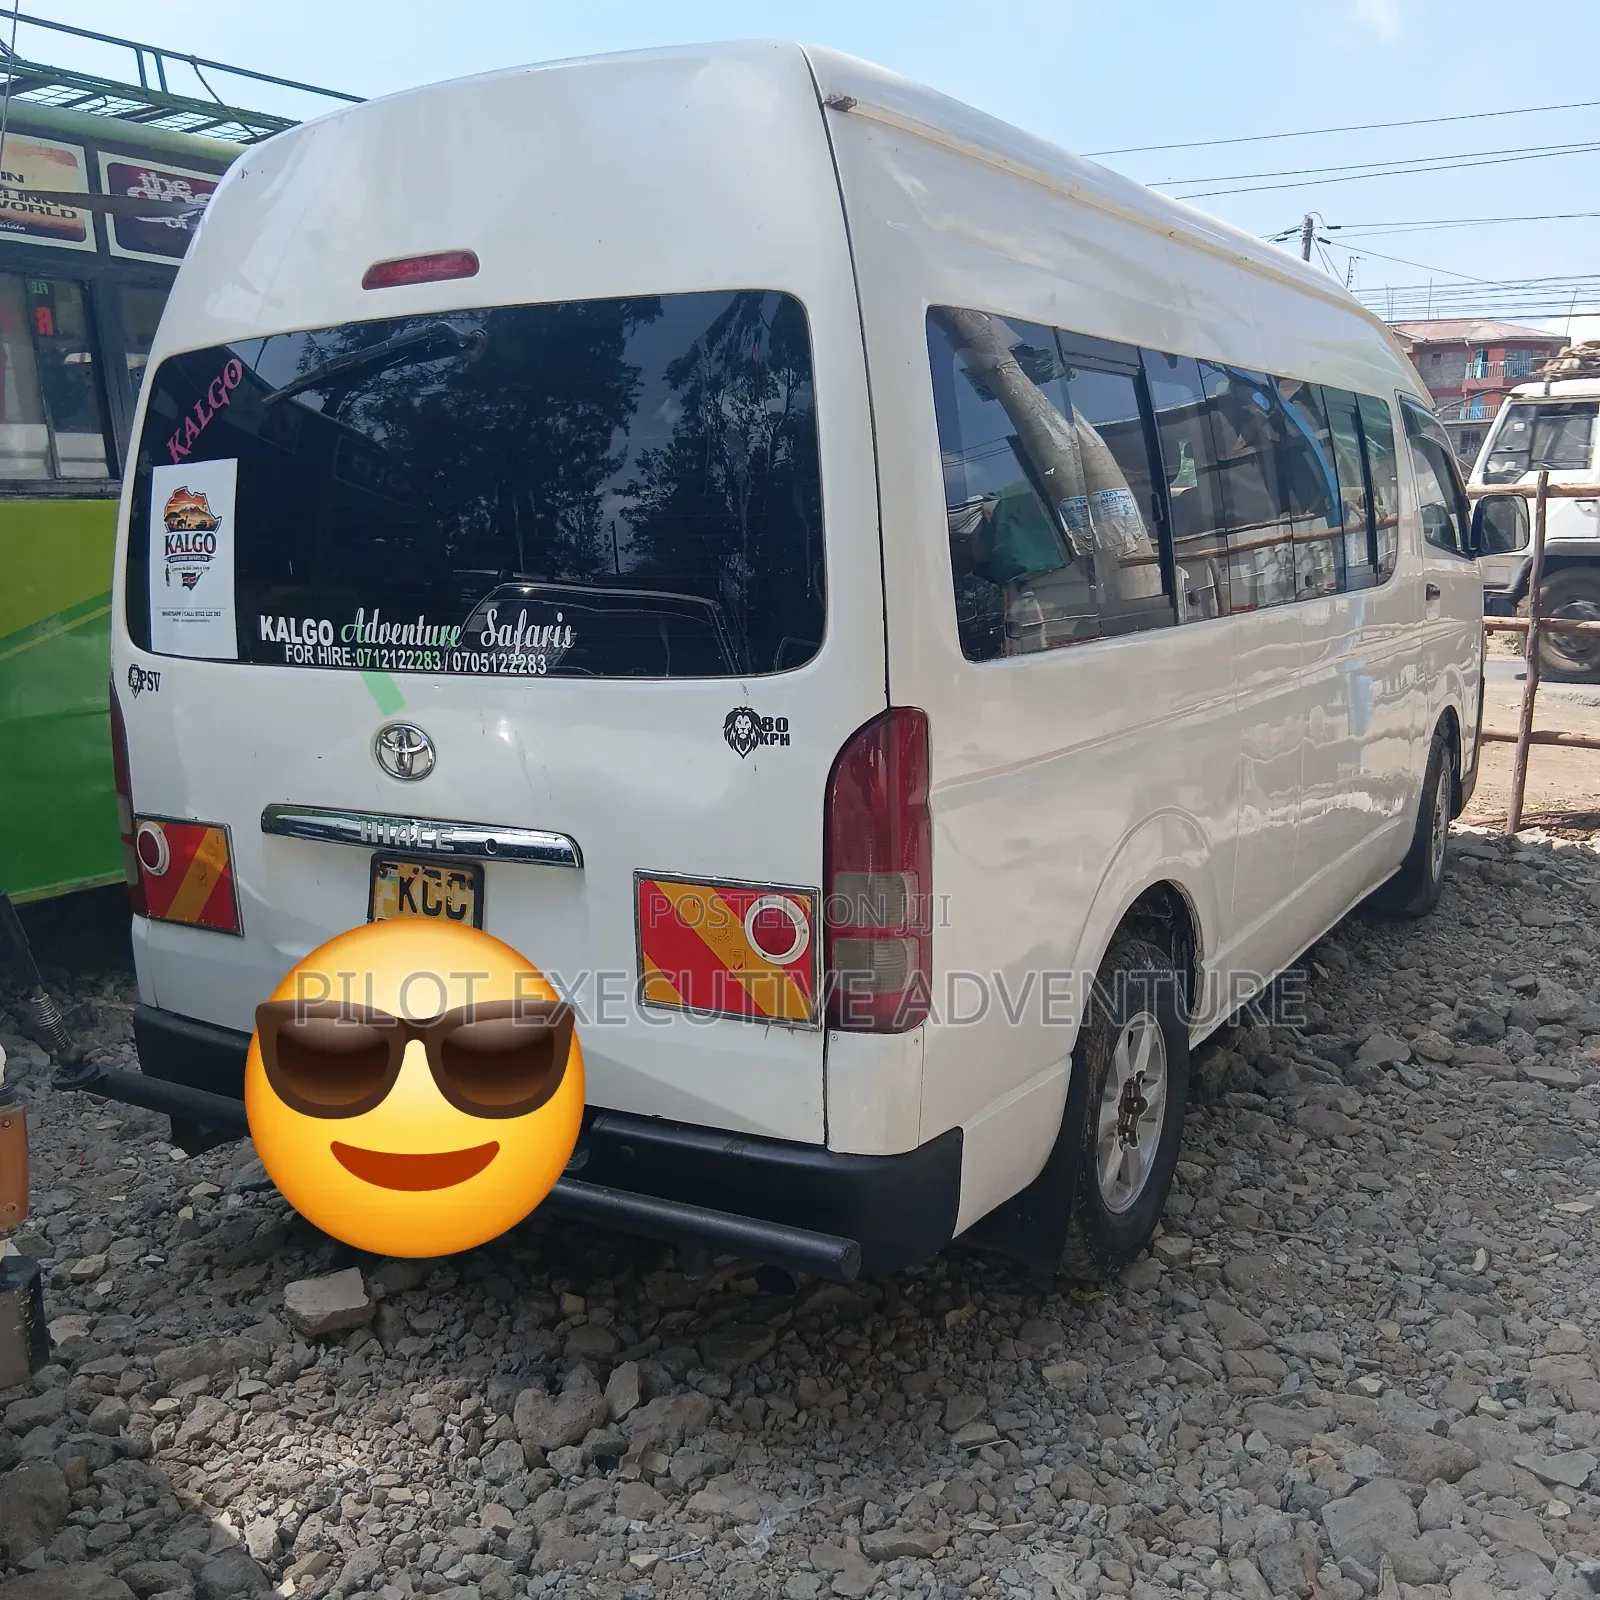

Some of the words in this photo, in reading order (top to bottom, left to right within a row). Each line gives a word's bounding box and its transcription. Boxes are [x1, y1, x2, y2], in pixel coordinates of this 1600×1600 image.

[166, 358, 243, 464] KALGO
[164, 532, 217, 556] KALGO
[260, 615, 334, 647] KALGO
[340, 607, 463, 648] Adventure
[480, 608, 575, 655] Safaris
[285, 644, 315, 664] FOR
[452, 652, 547, 674] 0705122283
[139, 670, 161, 692] PSV
[761, 716, 789, 732] 80
[760, 733, 790, 746] KPH
[360, 821, 454, 850] HIACE
[398, 868, 467, 920] KCC
